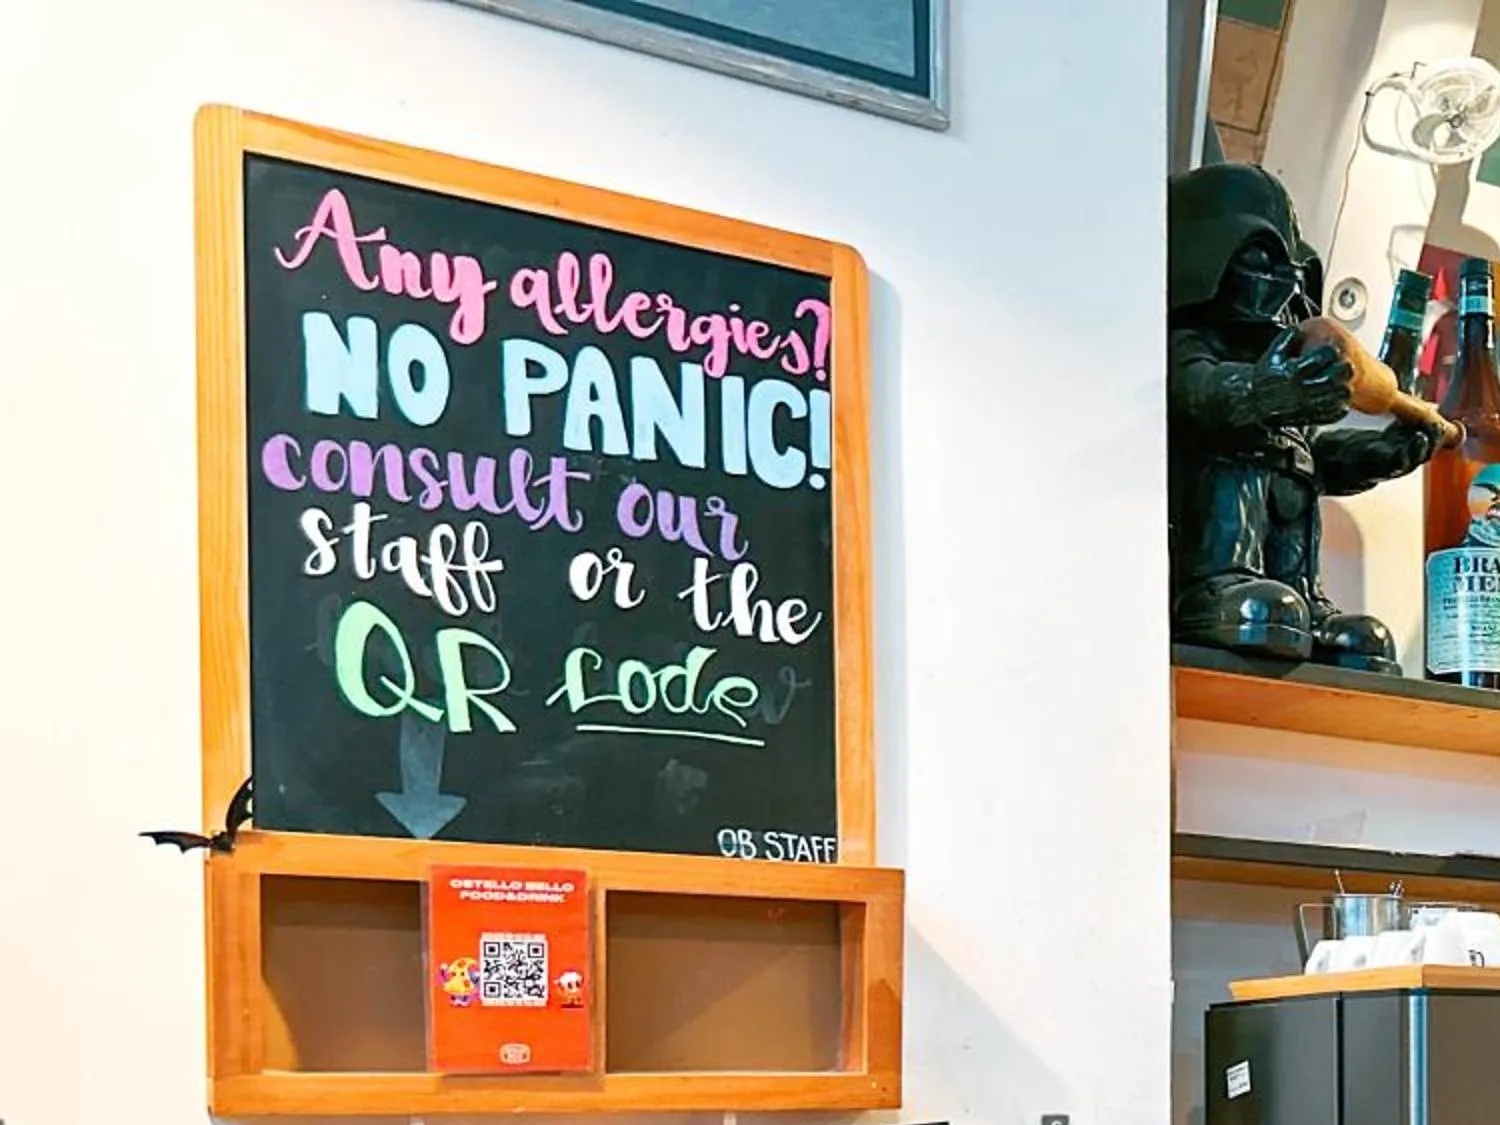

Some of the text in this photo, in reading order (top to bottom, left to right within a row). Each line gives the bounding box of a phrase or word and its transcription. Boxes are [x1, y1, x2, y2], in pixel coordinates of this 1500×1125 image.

[275, 189, 833, 382] Any allergies?
[302, 311, 832, 490] NO PANIC!
[261, 433, 749, 561] consult our
[302, 503, 823, 644] staff or the
[334, 602, 517, 733] QR
[717, 829, 837, 863] OB STAFF
